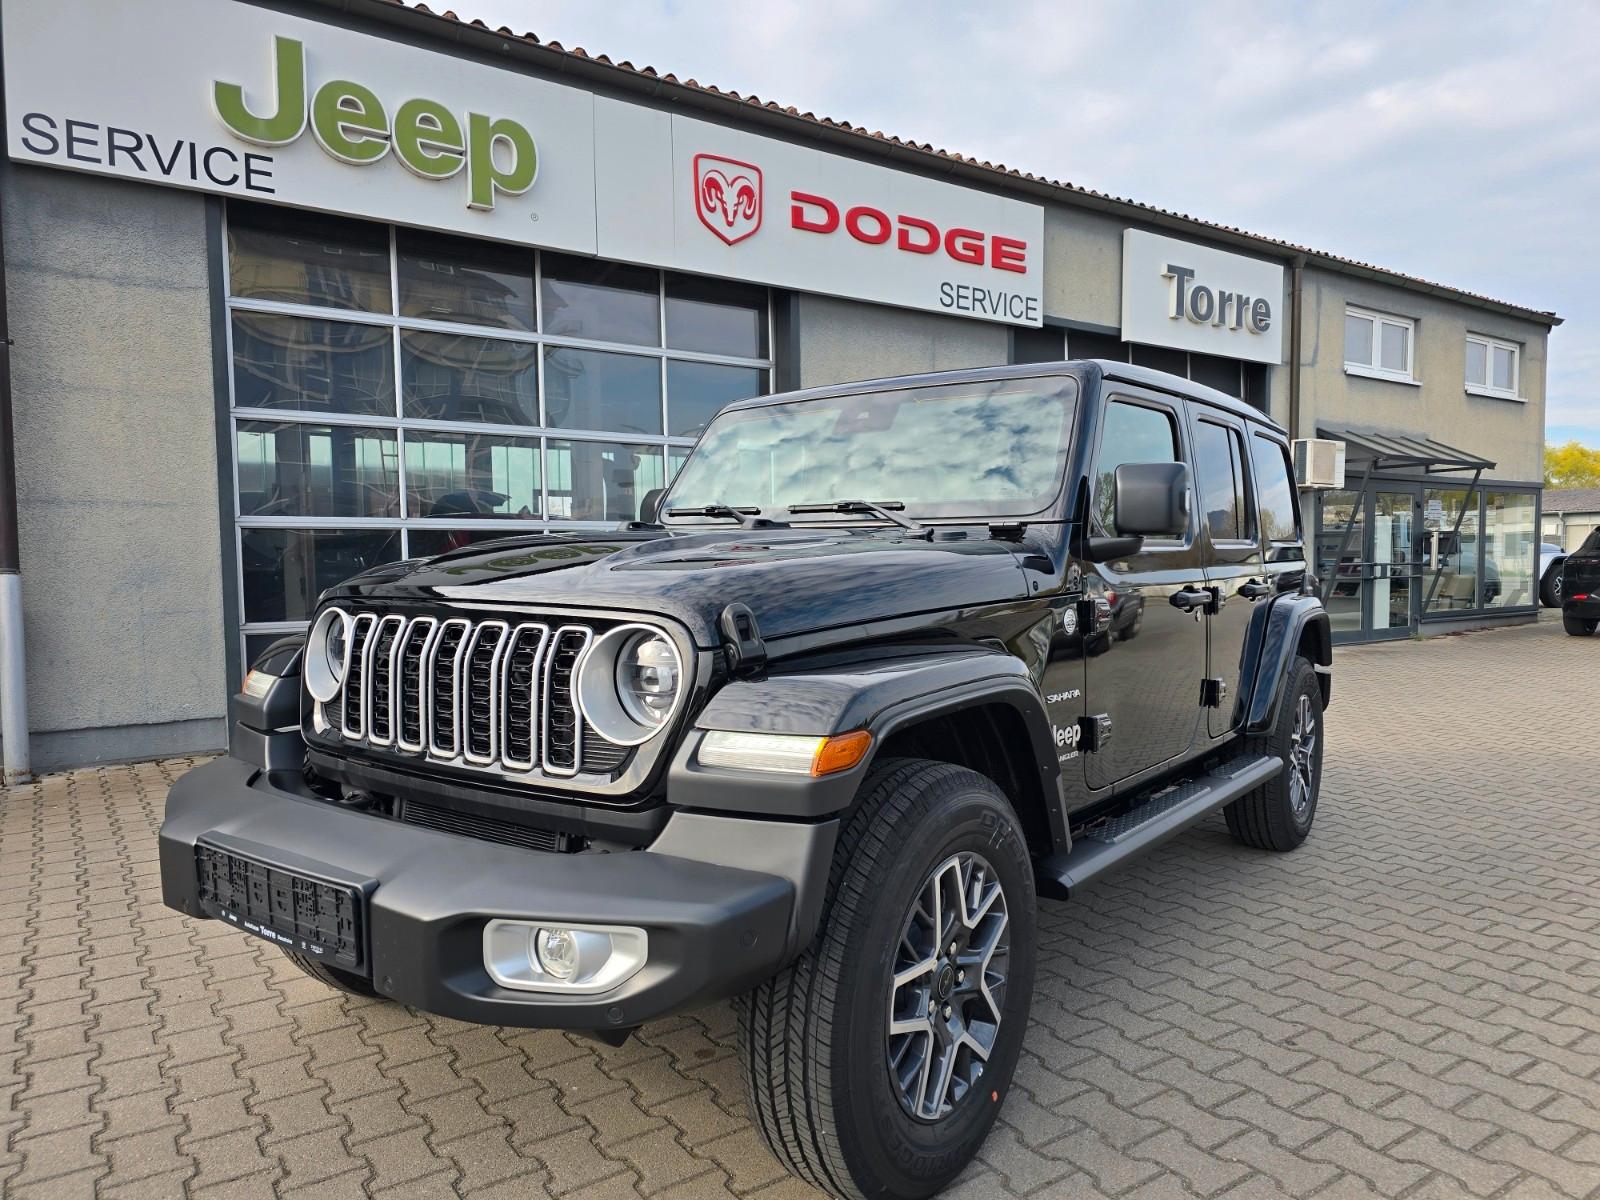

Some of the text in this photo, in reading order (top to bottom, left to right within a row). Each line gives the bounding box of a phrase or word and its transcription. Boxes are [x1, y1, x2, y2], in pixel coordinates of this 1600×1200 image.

[21, 112, 276, 194] SERVICE
[212, 35, 539, 211] Jeep
[790, 190, 1028, 275] DODGE
[938, 281, 1039, 322] SERVICE
[1161, 263, 1272, 334] Torre
[1046, 689, 1081, 703] SAHARA
